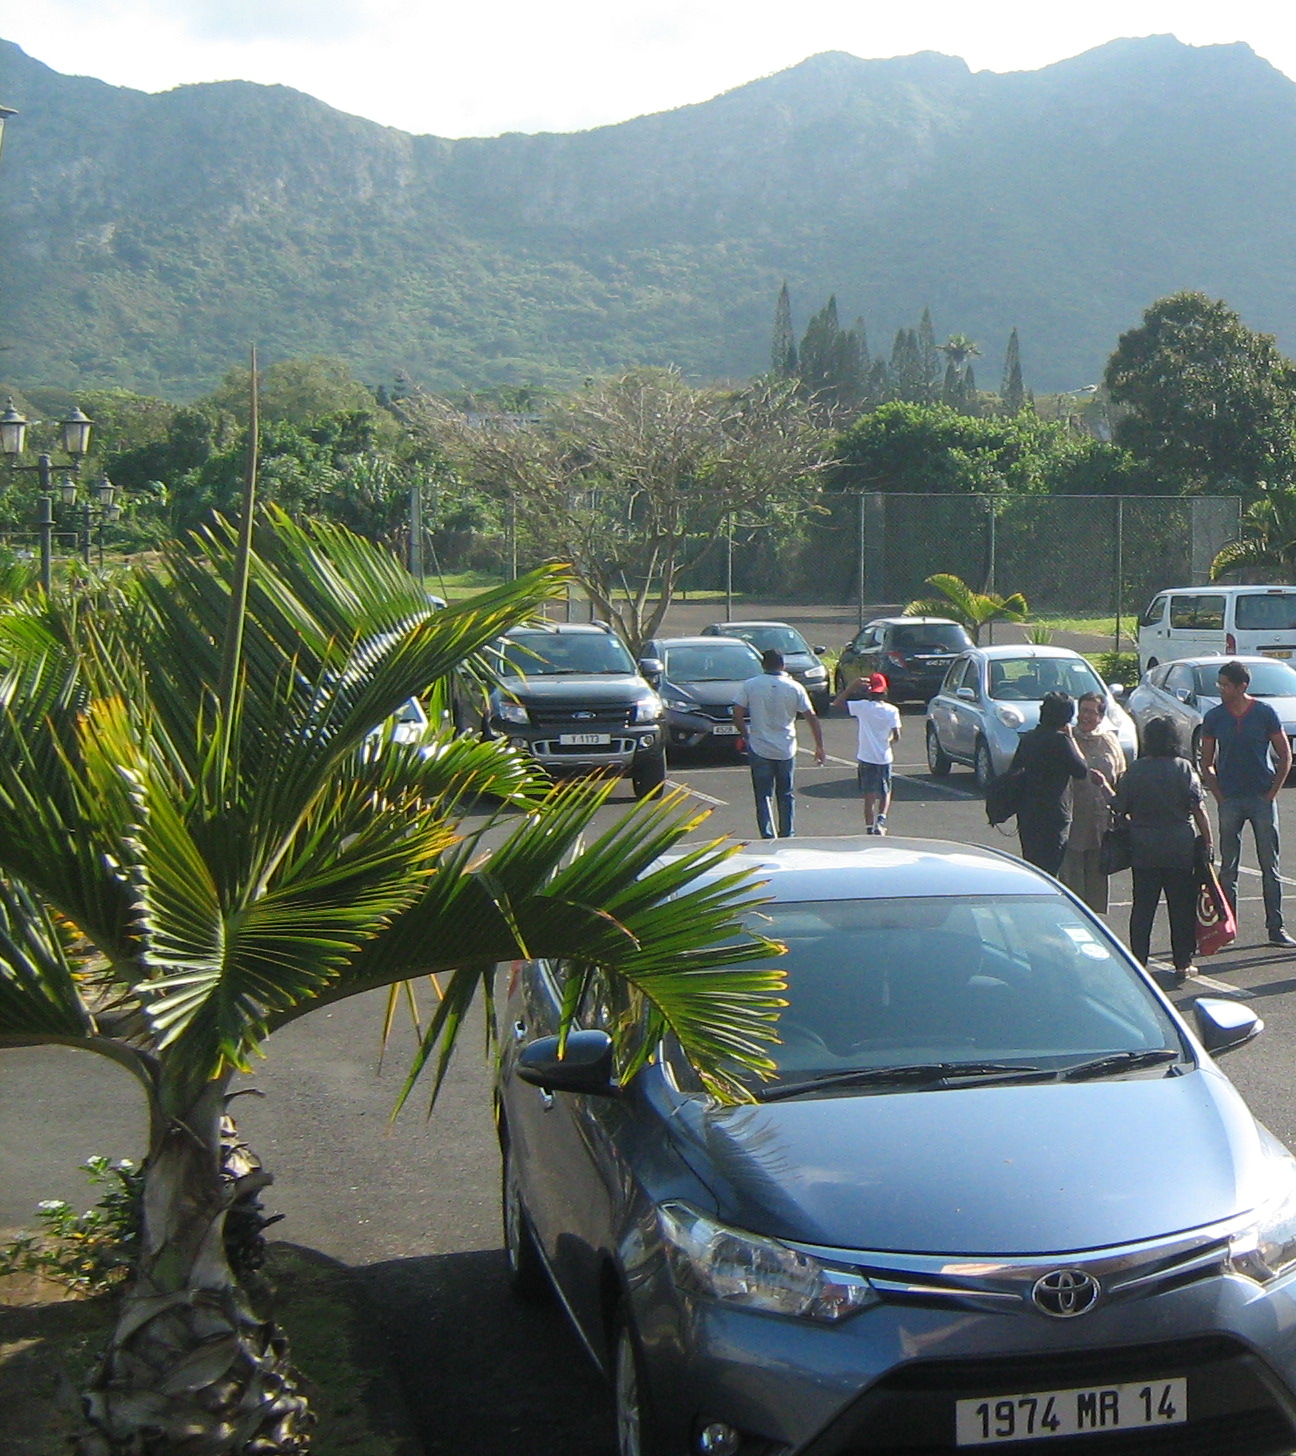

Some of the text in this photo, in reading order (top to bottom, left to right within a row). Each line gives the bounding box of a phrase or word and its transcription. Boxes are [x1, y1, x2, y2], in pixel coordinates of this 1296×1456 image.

[975, 1384, 1177, 1439] 1974 MR 14
